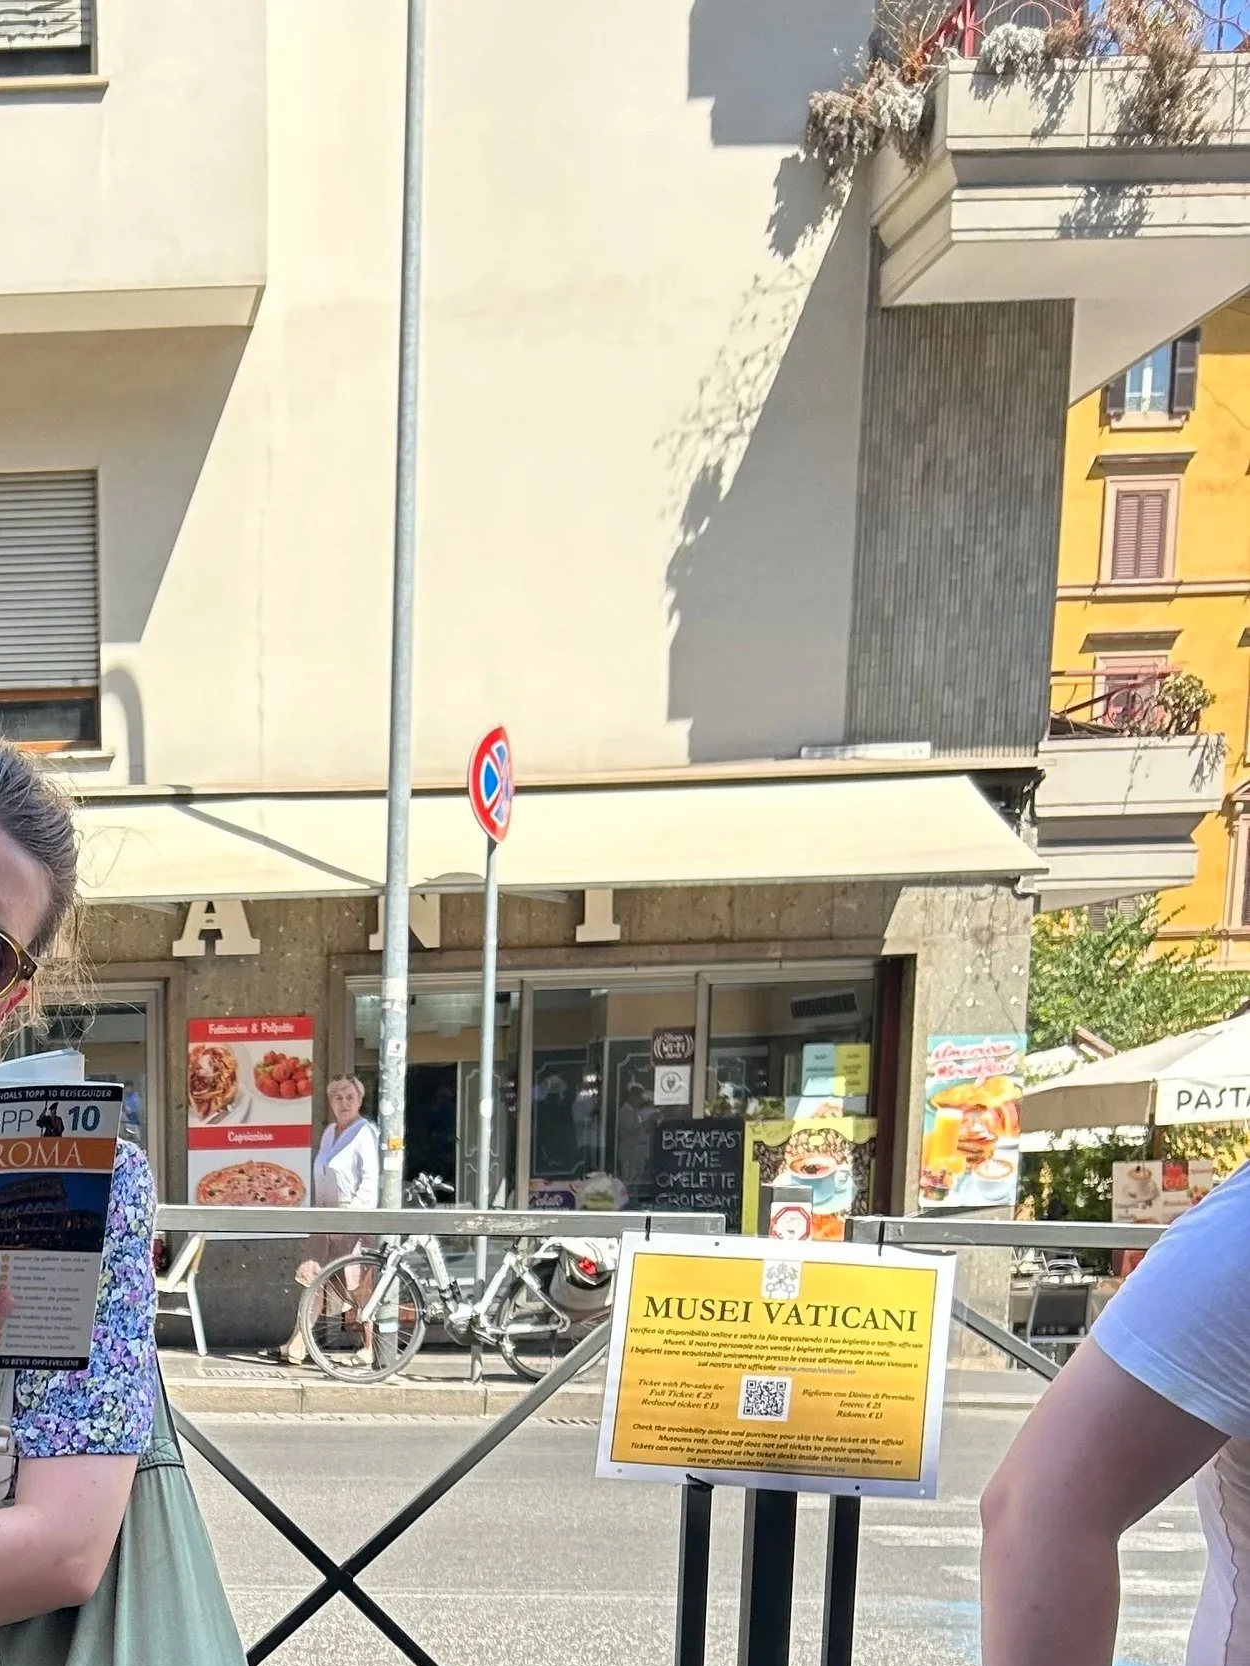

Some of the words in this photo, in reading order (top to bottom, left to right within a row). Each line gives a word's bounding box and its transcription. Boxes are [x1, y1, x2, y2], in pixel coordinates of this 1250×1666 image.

[1177, 1086, 1250, 1111] PAST
[68, 1105, 100, 1132] 10
[673, 1150, 721, 1168] TIME
[655, 1171, 736, 1190] OMELETTE
[655, 1193, 739, 1209] CROISSANT
[642, 1295, 753, 1323] MUSEI
[760, 1301, 918, 1332] VATICANI
[634, 1346, 662, 1355] biglietti
[765, 1354, 788, 1362] presso
[638, 1378, 661, 1386] Ticket
[649, 1388, 665, 1396] Full
[641, 1398, 676, 1407] Reduced
[667, 1425, 706, 1435] availability
[745, 1430, 777, 1439] purchase
[796, 1433, 811, 1441] skip
[839, 1435, 859, 1443] ticket
[658, 1434, 692, 1442] Museums
[726, 1439, 744, 1447] staff
[789, 1442, 811, 1450] tickets
[822, 1445, 846, 1453] people
[695, 1447, 732, 1456] purchased
[756, 1450, 776, 1458] ticket
[777, 1451, 796, 1459] desks
[834, 1455, 860, 1463] Vatican
[861, 1456, 893, 1465] Museums
[711, 1457, 735, 1466] official
